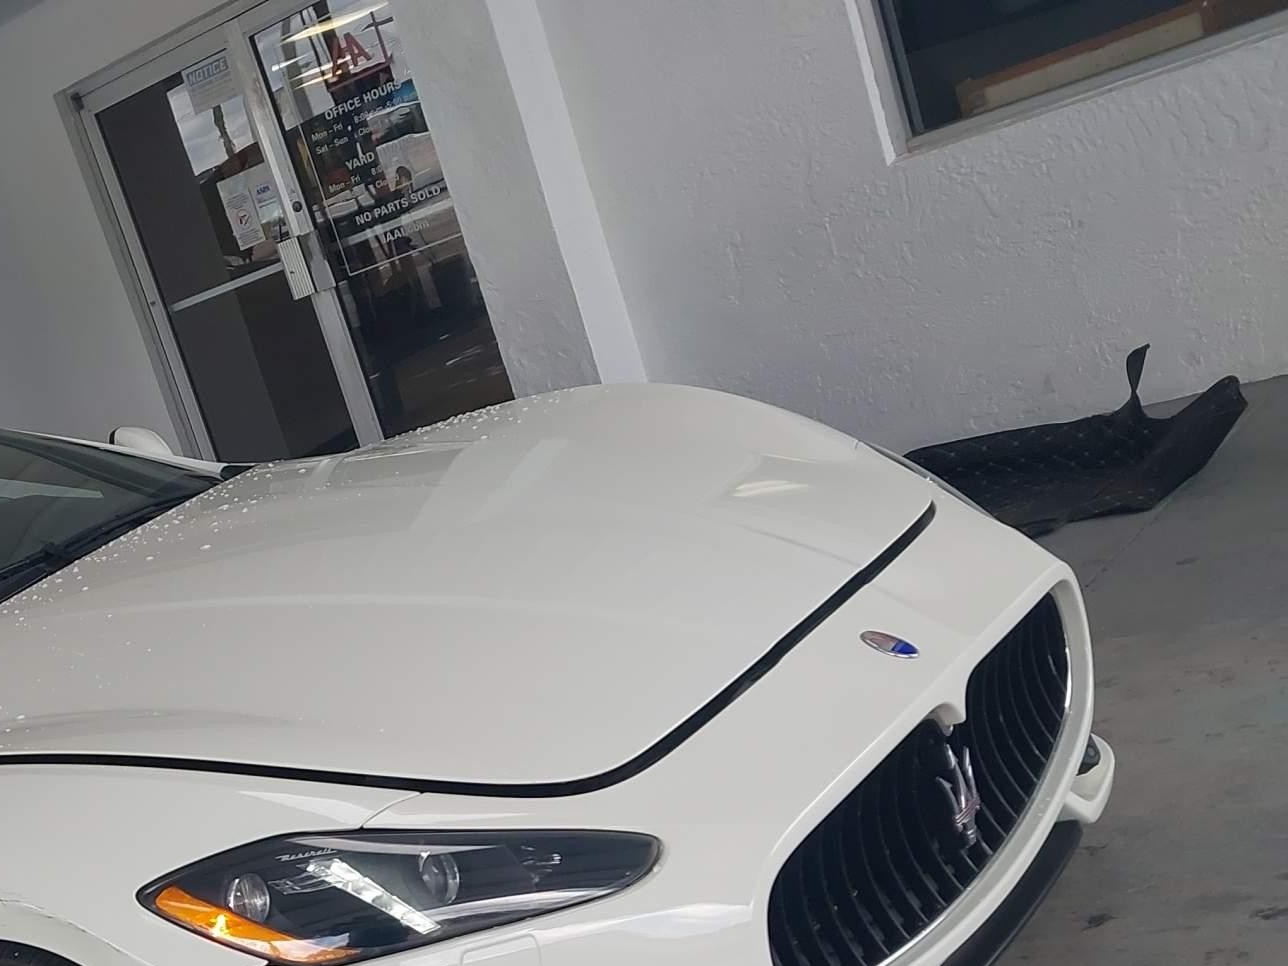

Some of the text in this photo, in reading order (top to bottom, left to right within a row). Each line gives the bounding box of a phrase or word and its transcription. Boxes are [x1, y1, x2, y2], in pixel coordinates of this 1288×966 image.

[188, 59, 227, 86] NOTICE
[324, 79, 403, 120] OFFICE HOURS
[311, 128, 328, 142] Mon
[333, 121, 343, 132] Fri
[315, 145, 329, 155] Sat
[333, 136, 349, 147] Sun
[345, 151, 375, 171] YARD
[328, 182, 346, 193] Mon
[350, 174, 361, 184] Fri
[355, 185, 441, 225] NO PARTS SOLD
